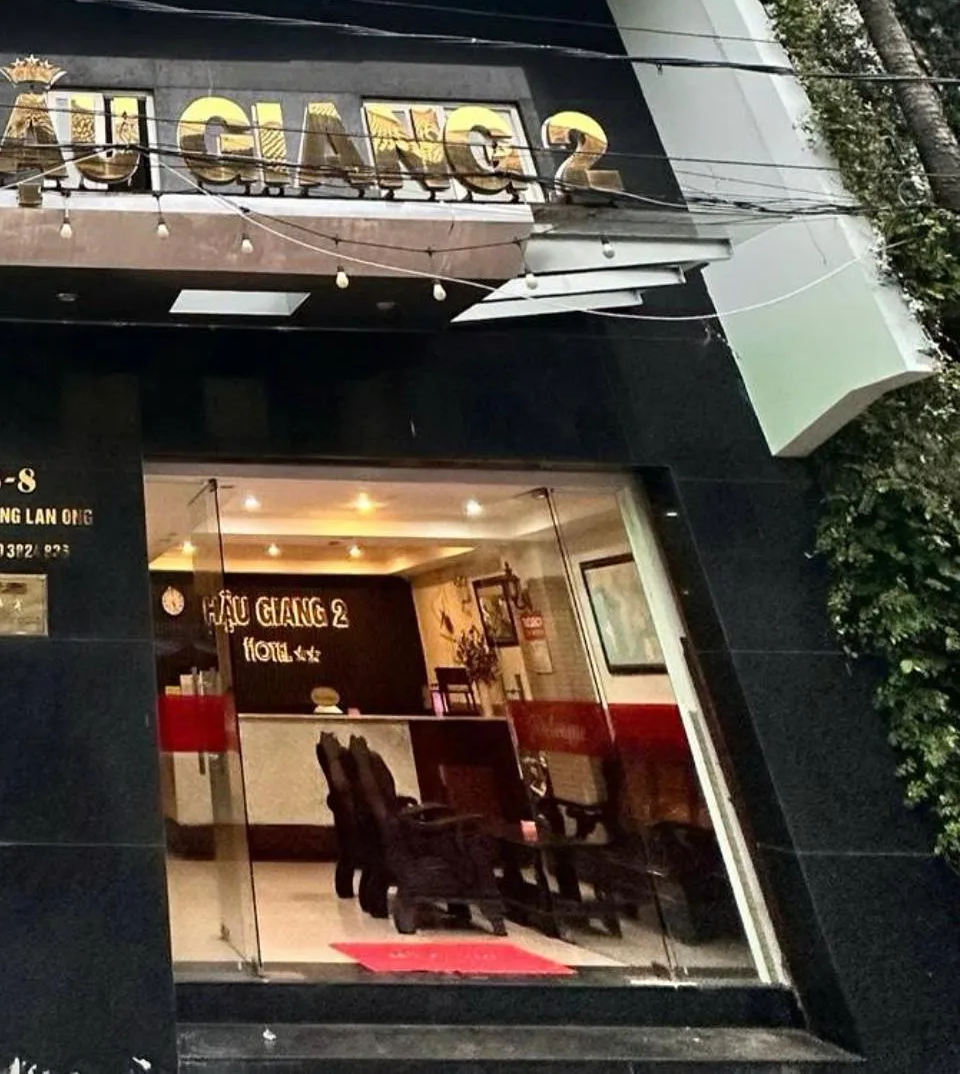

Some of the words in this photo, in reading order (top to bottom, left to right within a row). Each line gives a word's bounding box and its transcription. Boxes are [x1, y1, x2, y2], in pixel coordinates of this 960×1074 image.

[177, 95, 524, 196] GIANG
[542, 111, 623, 194] 2
[25, 508, 57, 526] LAN
[256, 596, 328, 628] GIANG
[331, 599, 350, 629] 2
